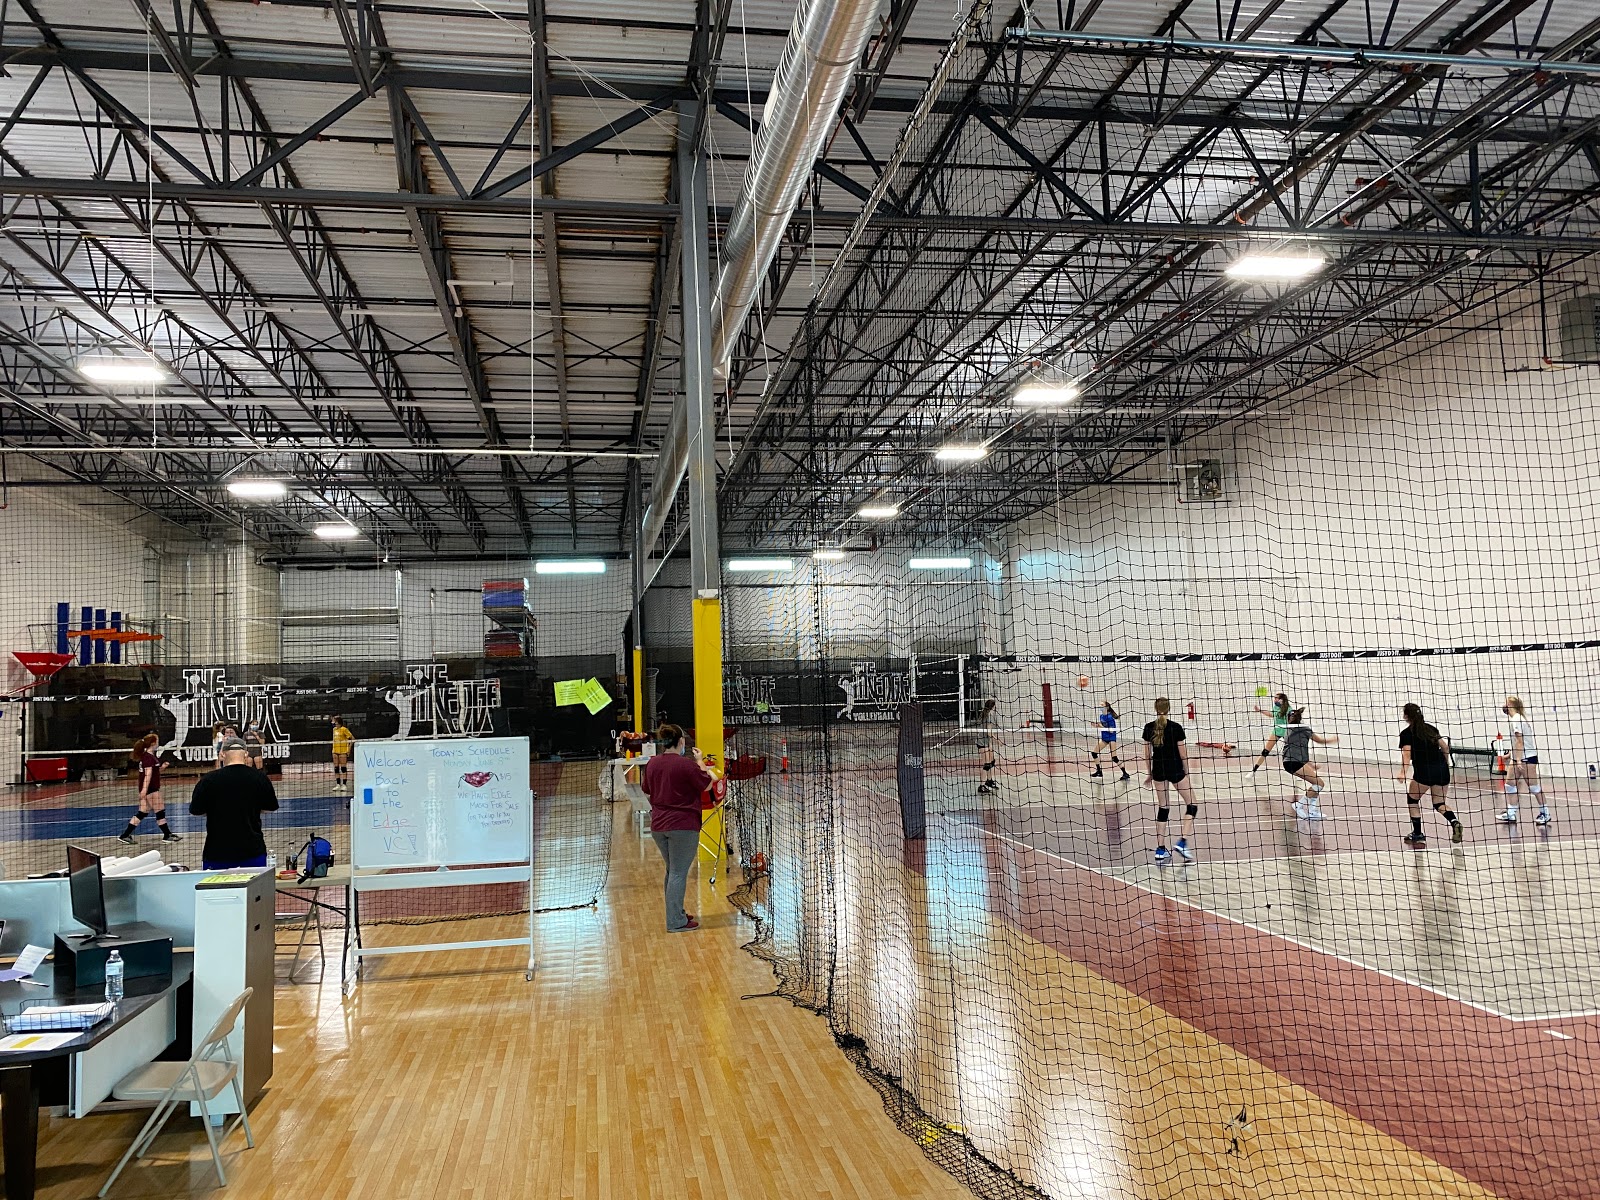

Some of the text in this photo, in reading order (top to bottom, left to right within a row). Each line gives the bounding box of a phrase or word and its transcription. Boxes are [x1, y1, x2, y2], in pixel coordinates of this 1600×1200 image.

[262, 744, 290, 759] CLUB
[431, 745, 514, 758] TODAY'S SCHEDULE:
[363, 749, 416, 768] Welcome
[375, 772, 409, 786] Back
[386, 788, 400, 797] to
[490, 788, 512, 800] EDGE
[382, 797, 404, 808] the
[490, 800, 502, 808] FOR
[505, 800, 520, 810] SALE
[372, 812, 408, 834] Edge
[384, 834, 418, 856] VC!
